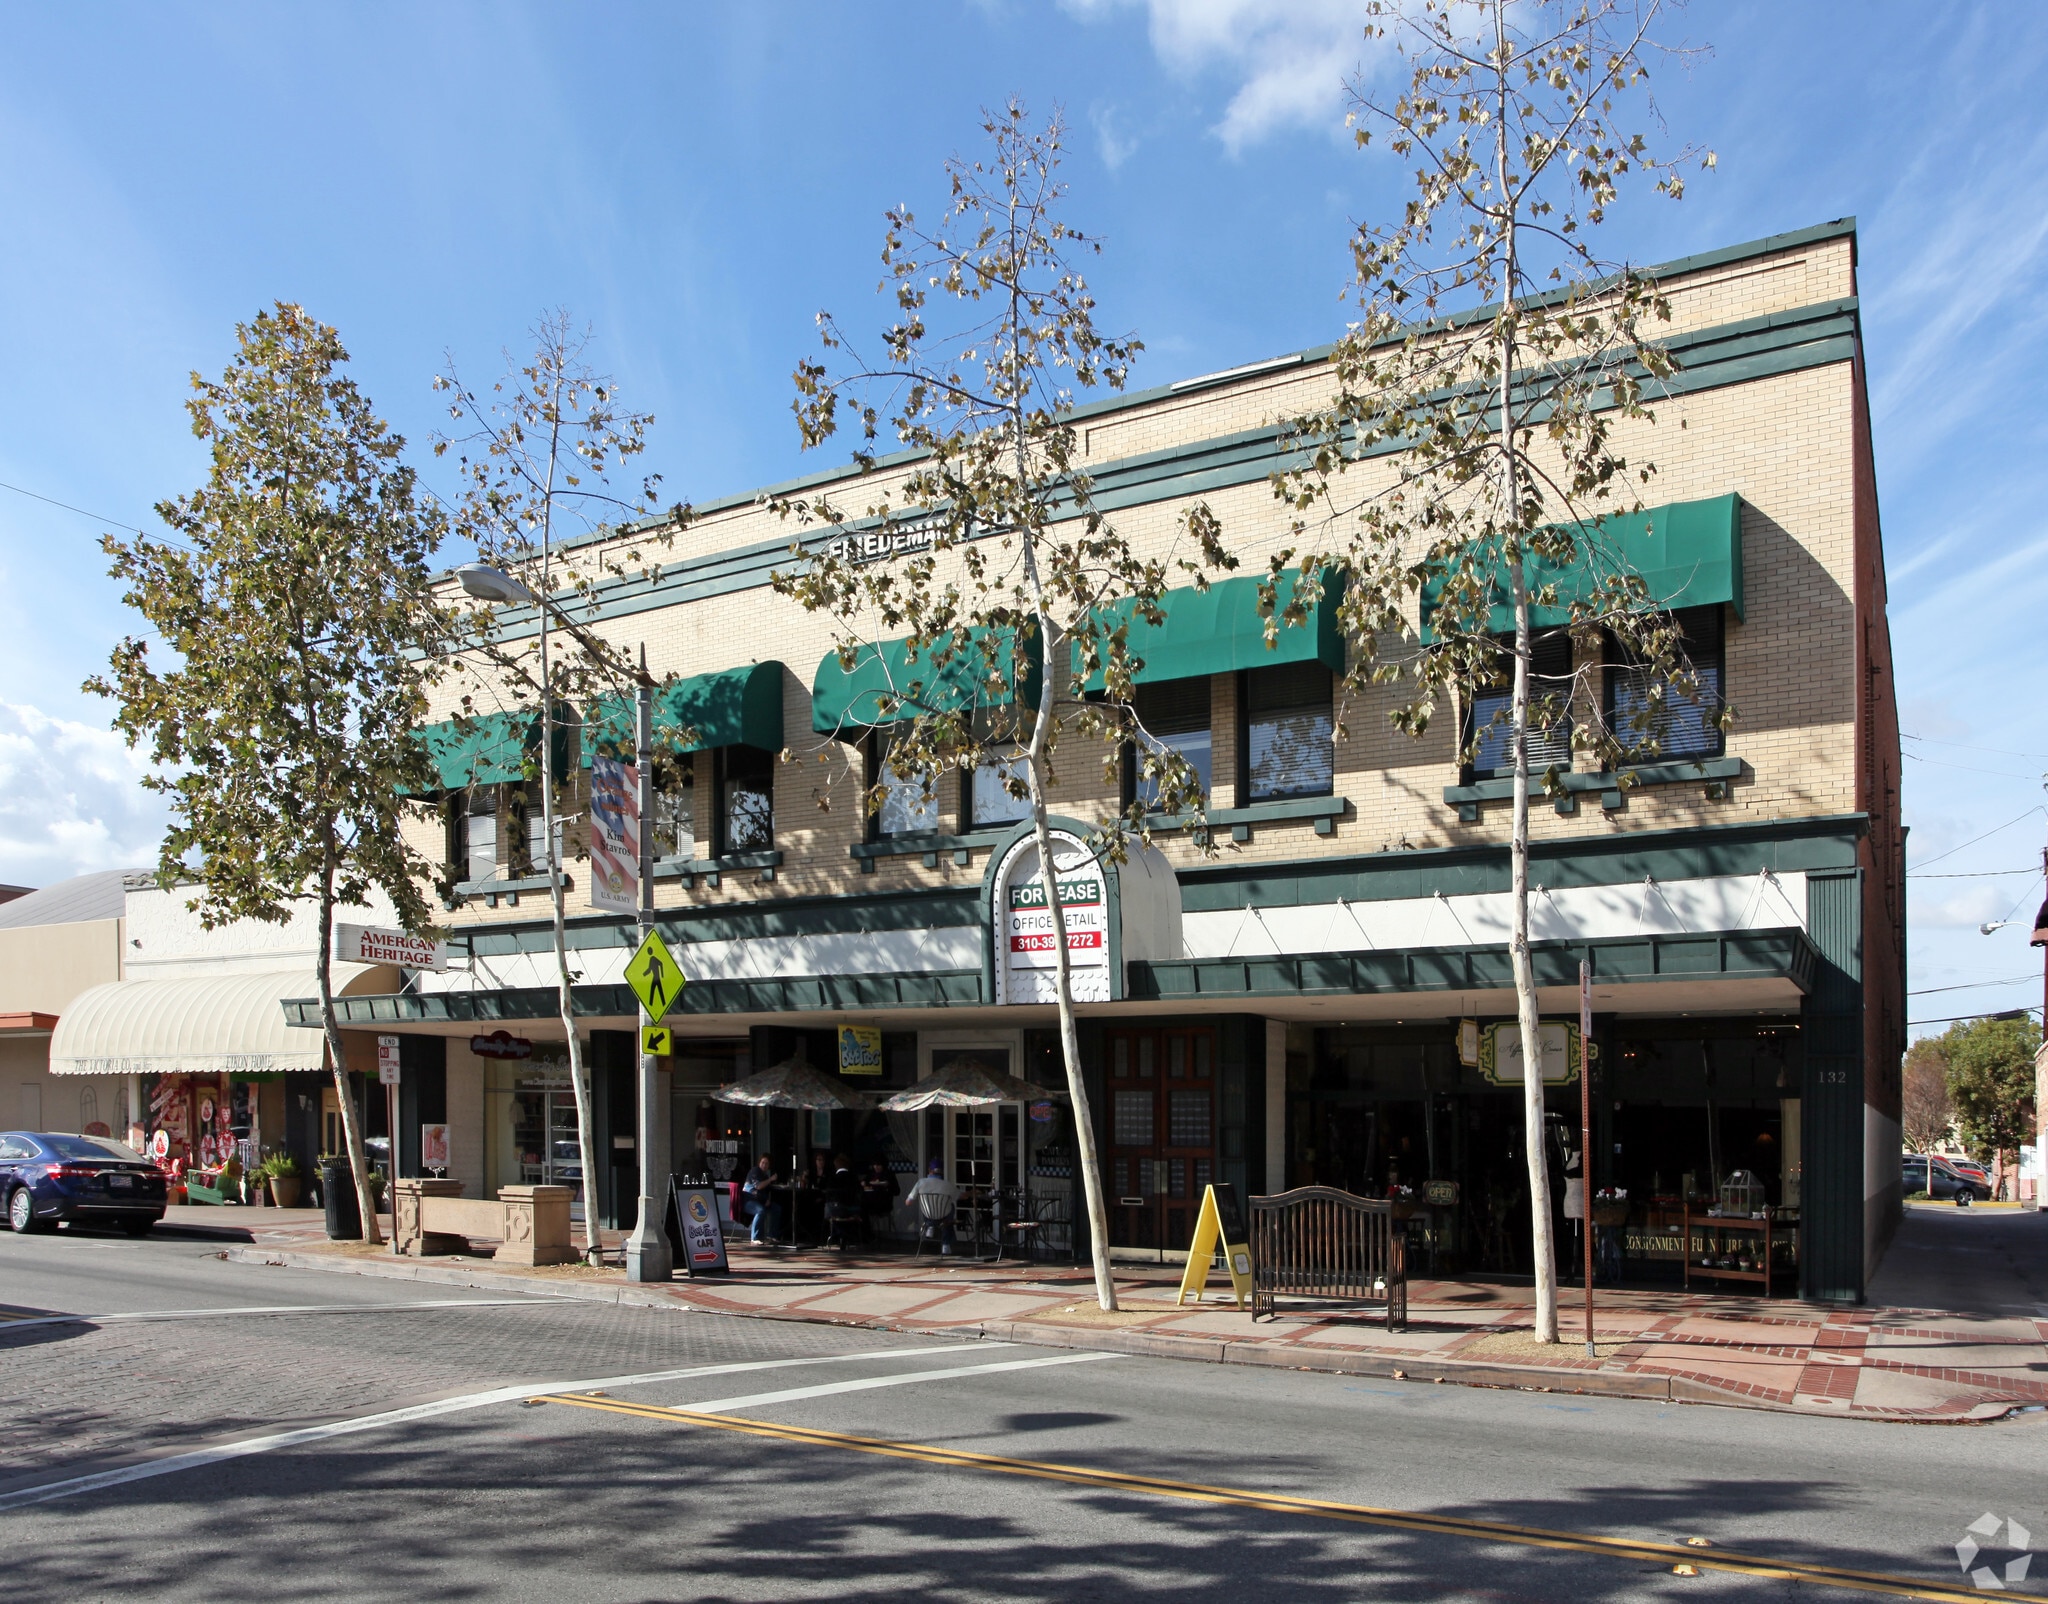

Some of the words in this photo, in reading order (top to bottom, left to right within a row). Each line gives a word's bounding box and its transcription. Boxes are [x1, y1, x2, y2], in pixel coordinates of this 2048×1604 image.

[606, 828, 625, 842] Kim
[600, 841, 632, 857] Stavros
[601, 891, 613, 900] U.S.
[614, 893, 631, 904] ARMY
[1012, 887, 1043, 905] FOR
[1048, 883, 1097, 901] EASE
[1013, 915, 1053, 930] OFFICE
[1062, 913, 1097, 927] ETAIL
[360, 930, 436, 952] AMERICAN
[1018, 934, 1094, 949] 310-397272
[360, 944, 434, 965] HERITAGE
[384, 1038, 396, 1046] END
[74, 1059, 88, 1072] THE
[251, 1054, 273, 1068] HOME
[1818, 1071, 1846, 1083] 132
[706, 1139, 725, 1153] SPOTTED
[725, 1140, 738, 1154] MOTH
[1429, 1187, 1453, 1198] OPEN
[697, 1238, 715, 1248] CAFE
[1691, 1237, 1743, 1254] FUNTURE
